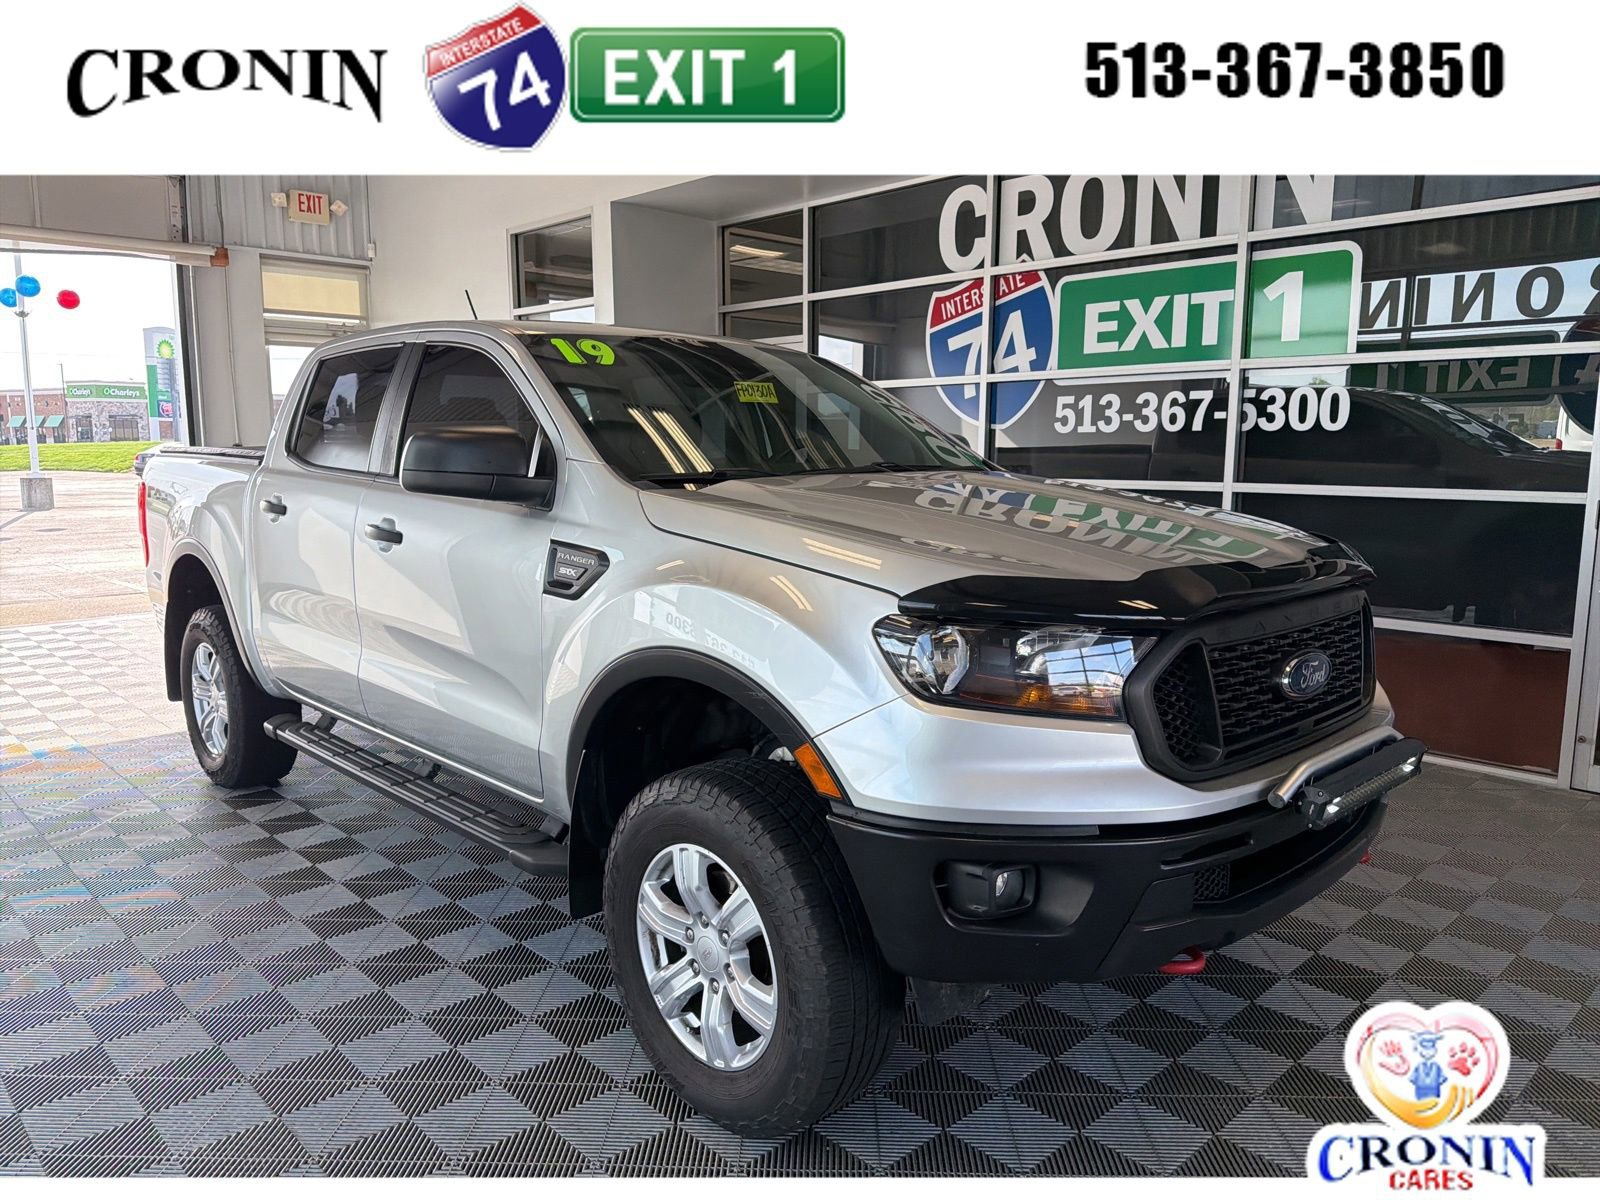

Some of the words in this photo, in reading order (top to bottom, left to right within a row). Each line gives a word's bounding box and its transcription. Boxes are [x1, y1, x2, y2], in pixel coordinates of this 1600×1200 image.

[298, 192, 323, 215] EXIT
[939, 175, 1334, 272] CRONIN
[941, 273, 1025, 320] INTERATE
[1083, 289, 1235, 354] EXIT
[1263, 270, 1304, 342] 1
[550, 338, 616, 366] 19
[947, 309, 1037, 400] 74
[558, 552, 595, 566] RANGER
[558, 567, 577, 577] STX
[1300, 660, 1326, 689] Ford
